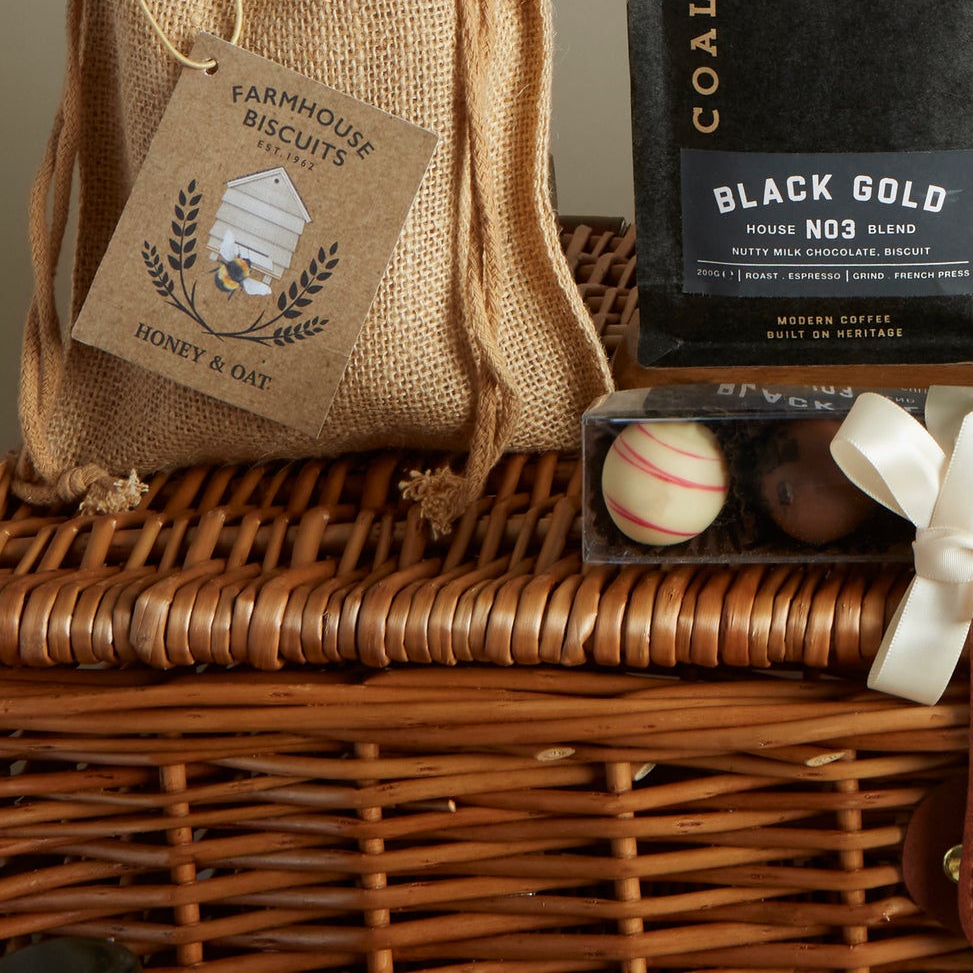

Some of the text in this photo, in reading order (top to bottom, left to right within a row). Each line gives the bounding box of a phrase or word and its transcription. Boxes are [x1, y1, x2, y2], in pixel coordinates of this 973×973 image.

[231, 85, 375, 160] FARMHOUSE
[242, 109, 347, 166] BISCUITS
[713, 174, 947, 214] BLACK GOLD
[746, 224, 796, 235] HOUSE
[868, 224, 917, 235] BLEND
[732, 247, 769, 256] NUTTY
[773, 248, 801, 256] MILK
[884, 247, 931, 256] BISCUIT
[745, 272, 778, 280] ROAST
[788, 272, 841, 280] ESPRESSO
[853, 272, 885, 280] GRIND
[894, 270, 935, 280] FRENCH
[938, 269, 970, 278] PRESS
[777, 314, 891, 325] MODERN COFFEE
[767, 328, 903, 339] BUILT ON HERITAGE
[134, 322, 204, 364] HONEY
[208, 354, 225, 373] &
